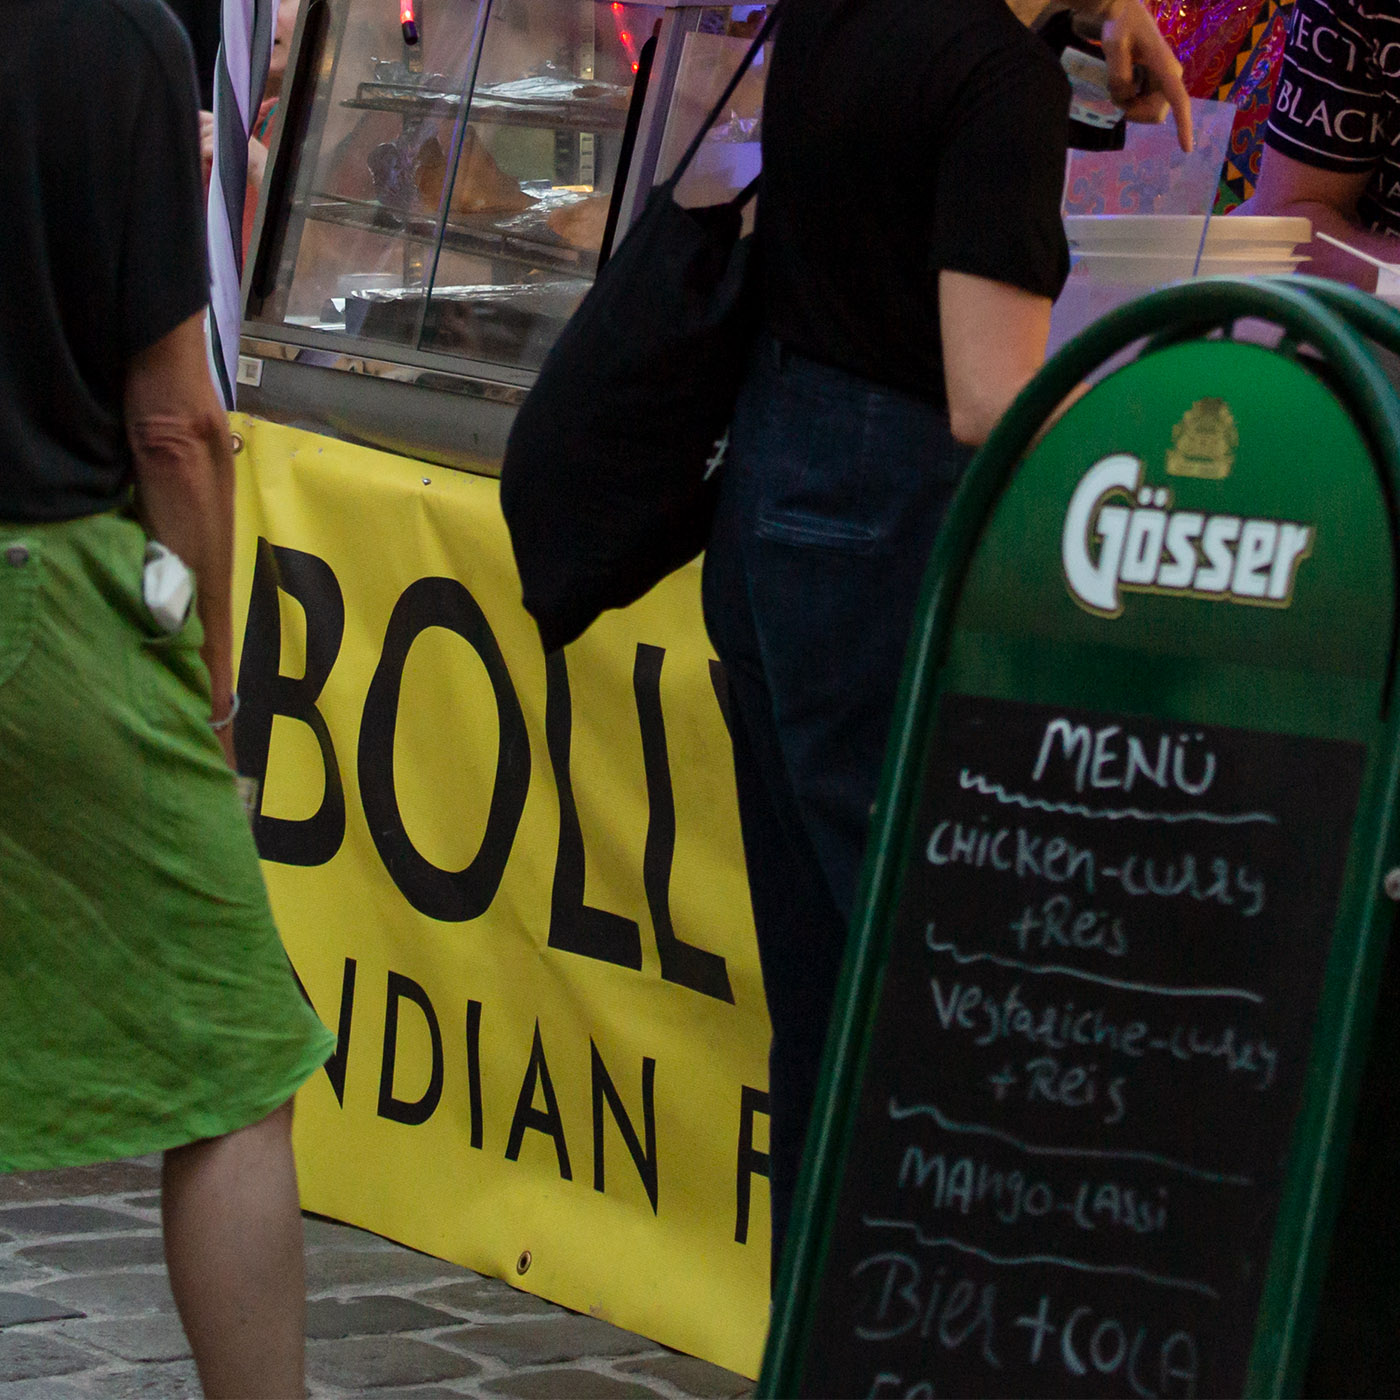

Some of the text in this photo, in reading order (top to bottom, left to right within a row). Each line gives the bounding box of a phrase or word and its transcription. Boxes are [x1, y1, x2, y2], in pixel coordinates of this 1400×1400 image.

[1276, 79, 1387, 143] BLACK
[1061, 451, 1314, 617] Gösser
[232, 536, 737, 1006] BOLL
[1031, 717, 1216, 795] MENÜ
[292, 957, 660, 1218] NDIAN
[851, 1250, 1001, 1369] Bier
